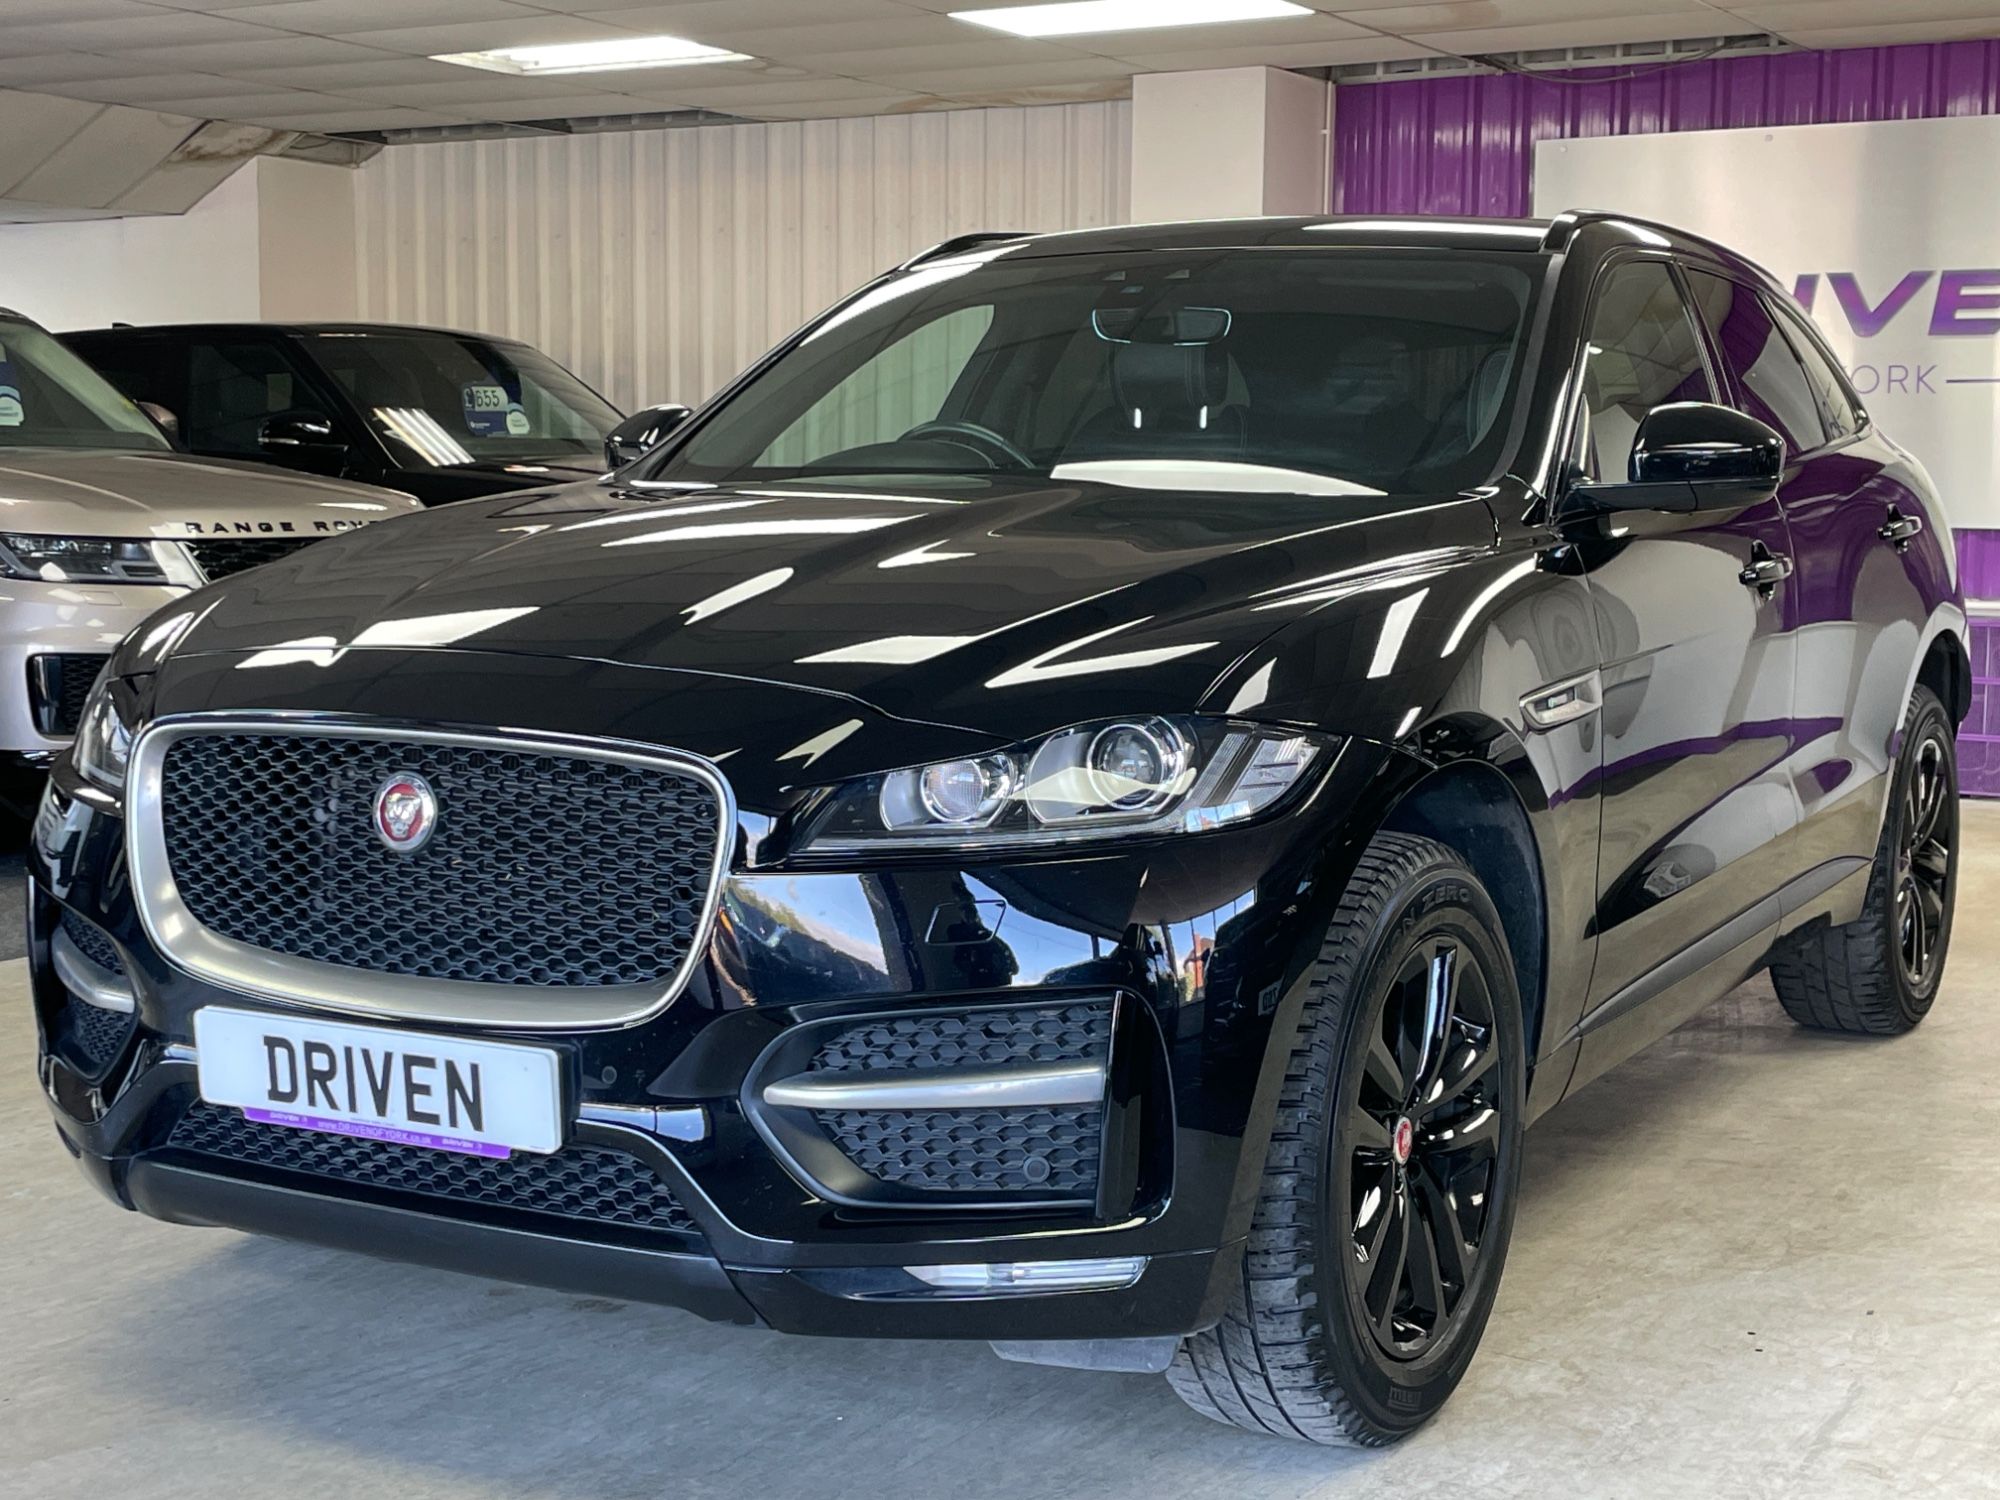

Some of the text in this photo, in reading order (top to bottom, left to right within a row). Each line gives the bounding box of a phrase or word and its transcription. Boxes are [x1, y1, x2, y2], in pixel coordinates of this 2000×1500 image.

[1843, 364, 1938, 395] ORK
[185, 519, 379, 534] RANGE ROV
[1422, 884, 1473, 914] ZERO
[263, 1035, 484, 1132] DRIVEN
